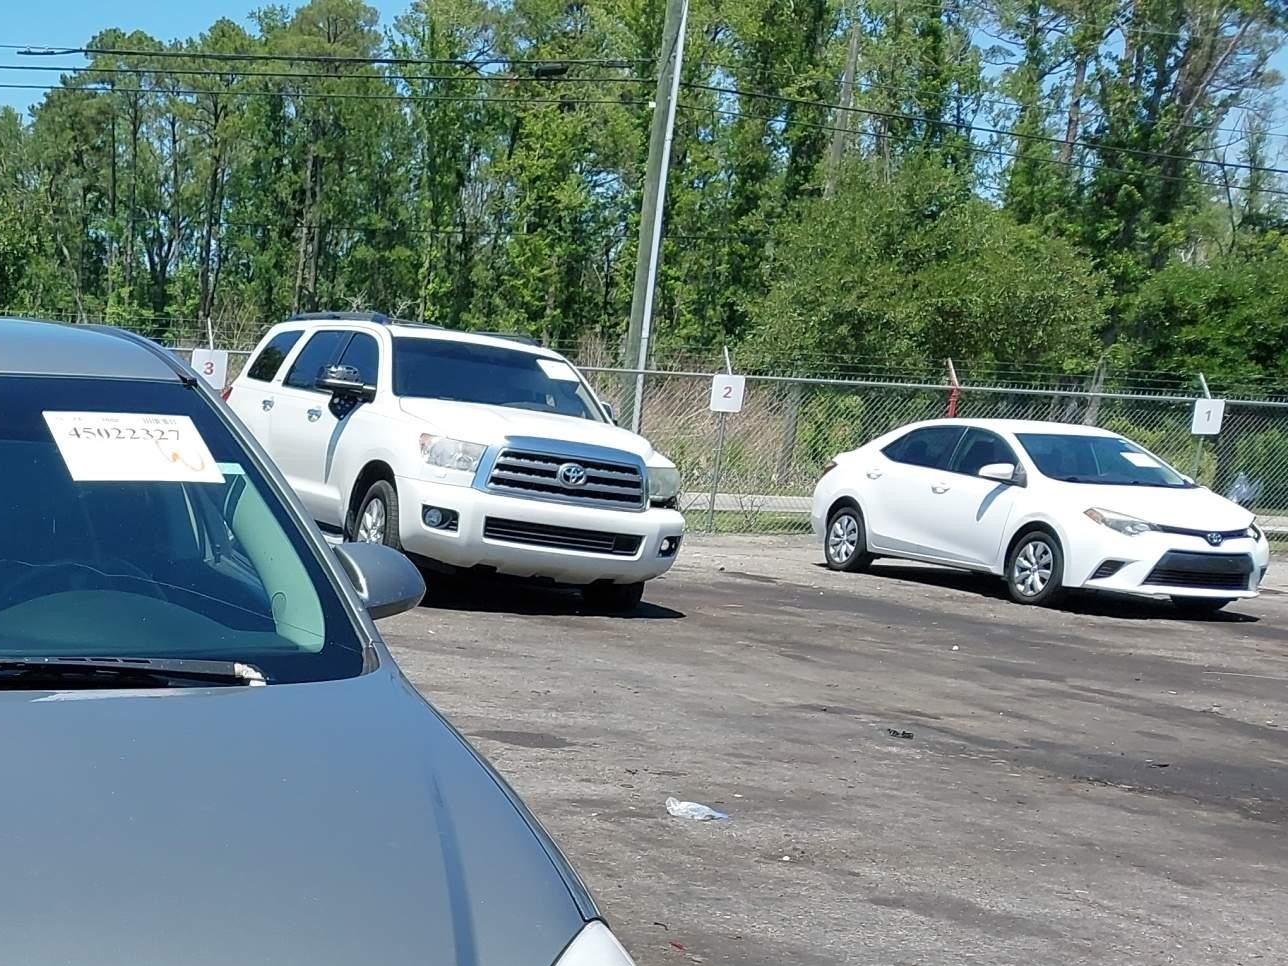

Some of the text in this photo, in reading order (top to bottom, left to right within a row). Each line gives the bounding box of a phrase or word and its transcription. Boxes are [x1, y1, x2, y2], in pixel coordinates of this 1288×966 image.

[203, 361, 214, 375] 3
[722, 386, 732, 398] 2
[1204, 410, 1211, 422] 1
[68, 427, 180, 441] 45022327
